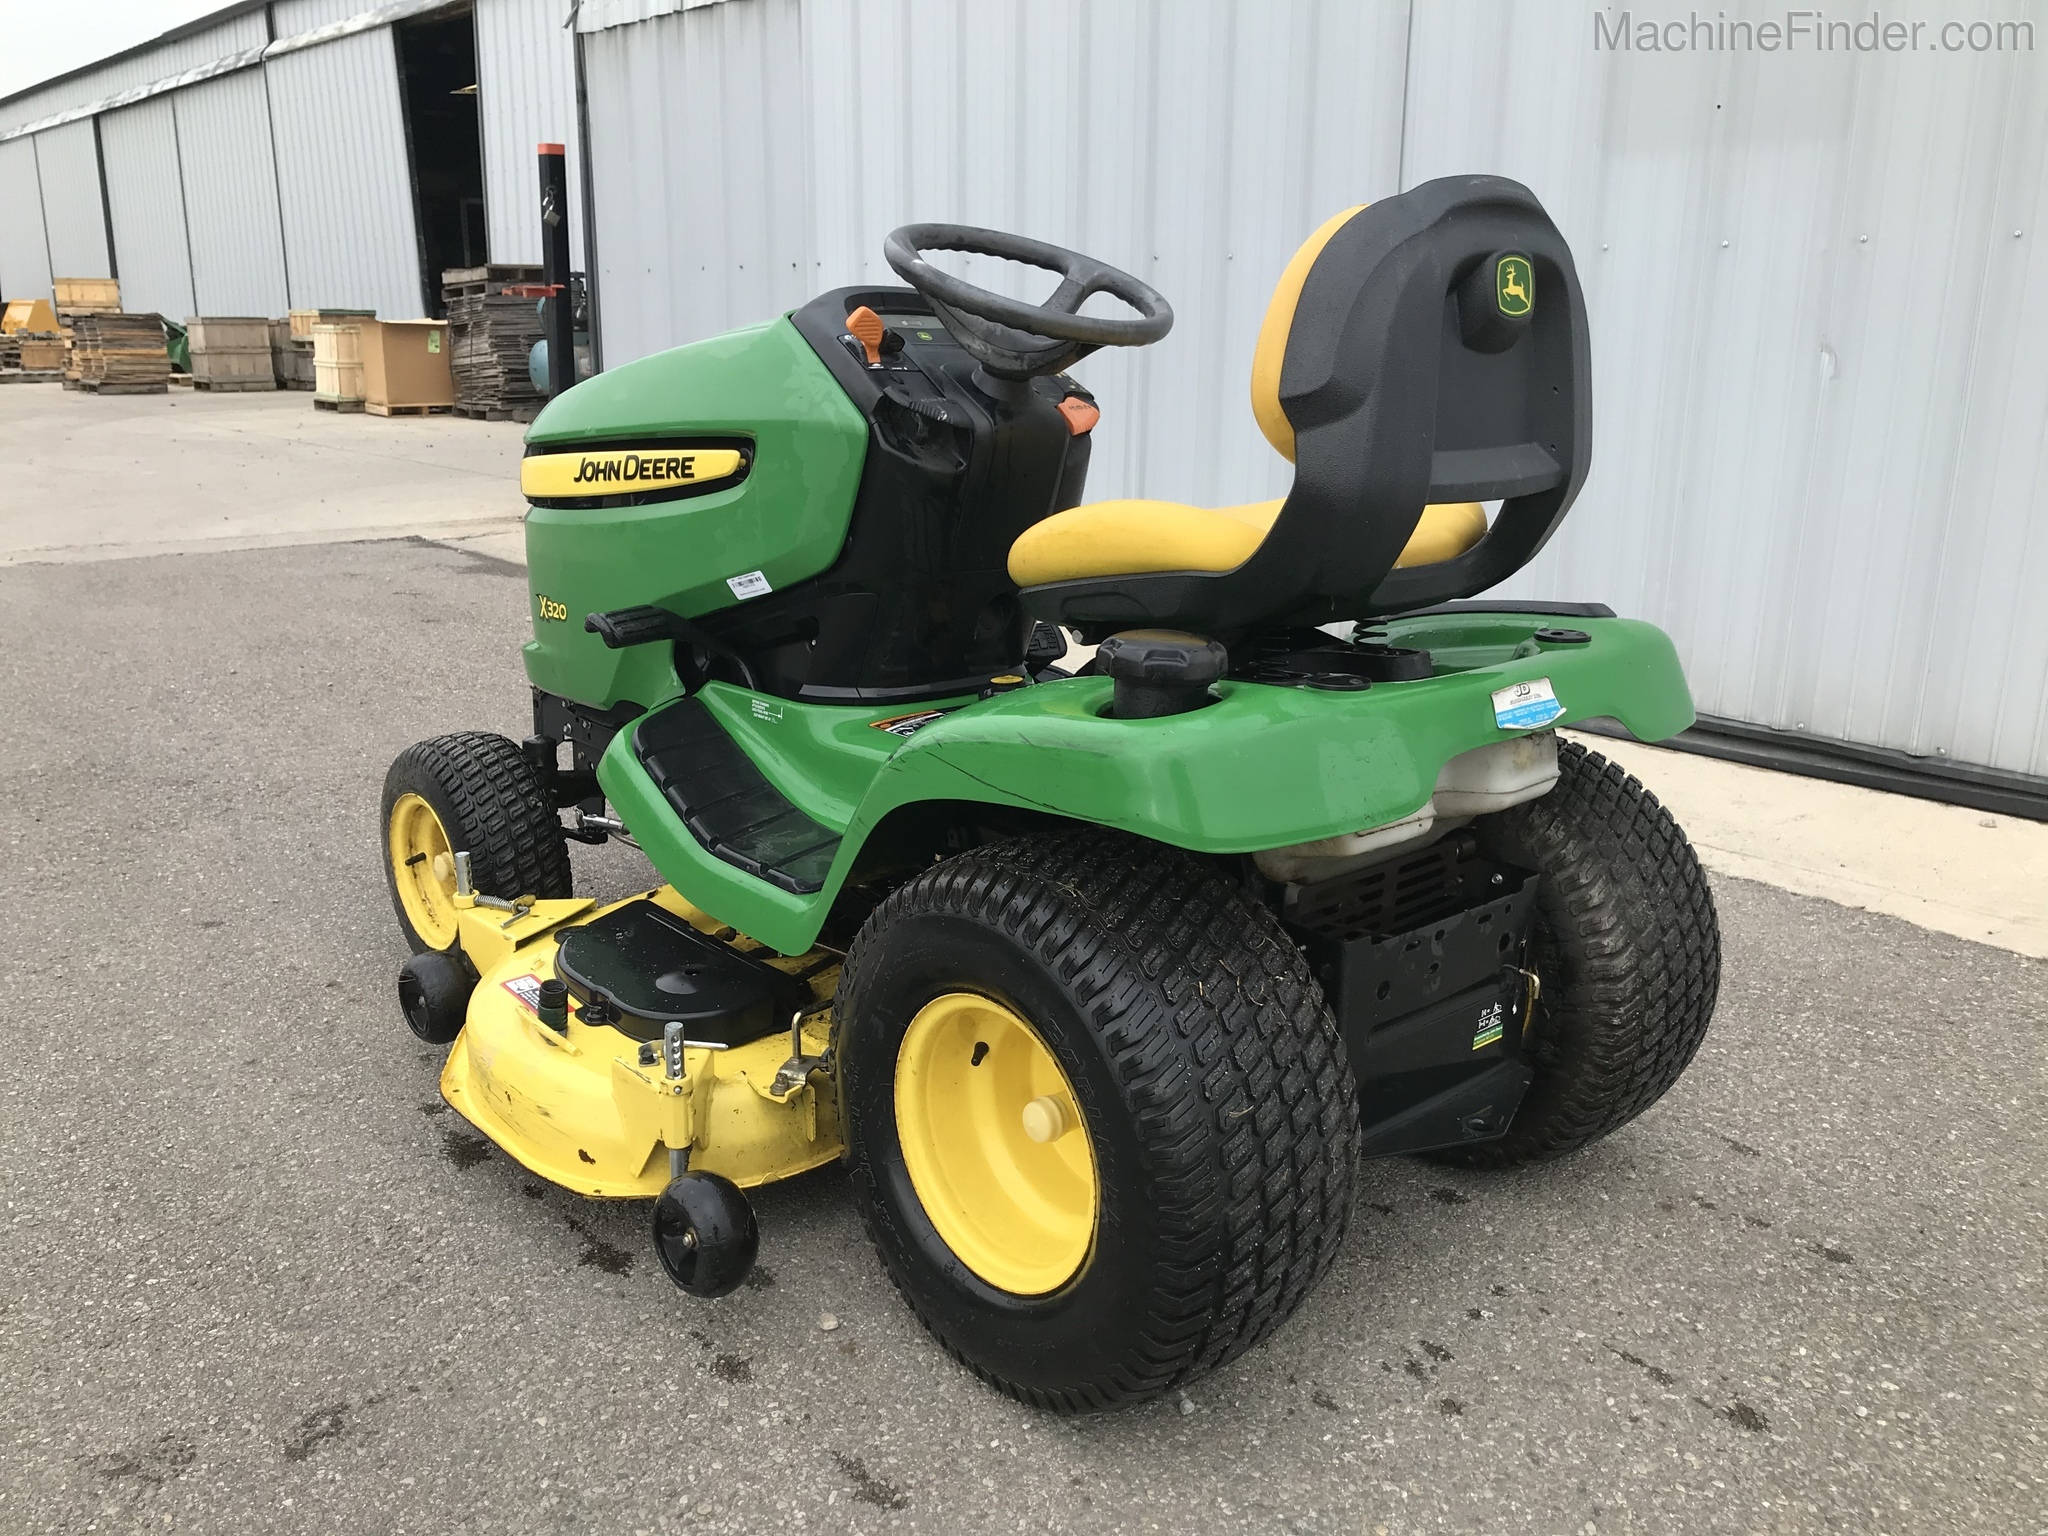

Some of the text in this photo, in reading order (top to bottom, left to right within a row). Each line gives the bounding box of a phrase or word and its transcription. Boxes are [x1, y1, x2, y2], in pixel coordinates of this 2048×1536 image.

[573, 454, 695, 483] JOHN DEERE
[538, 594, 567, 621] X320
[1513, 682, 1531, 697] JD
